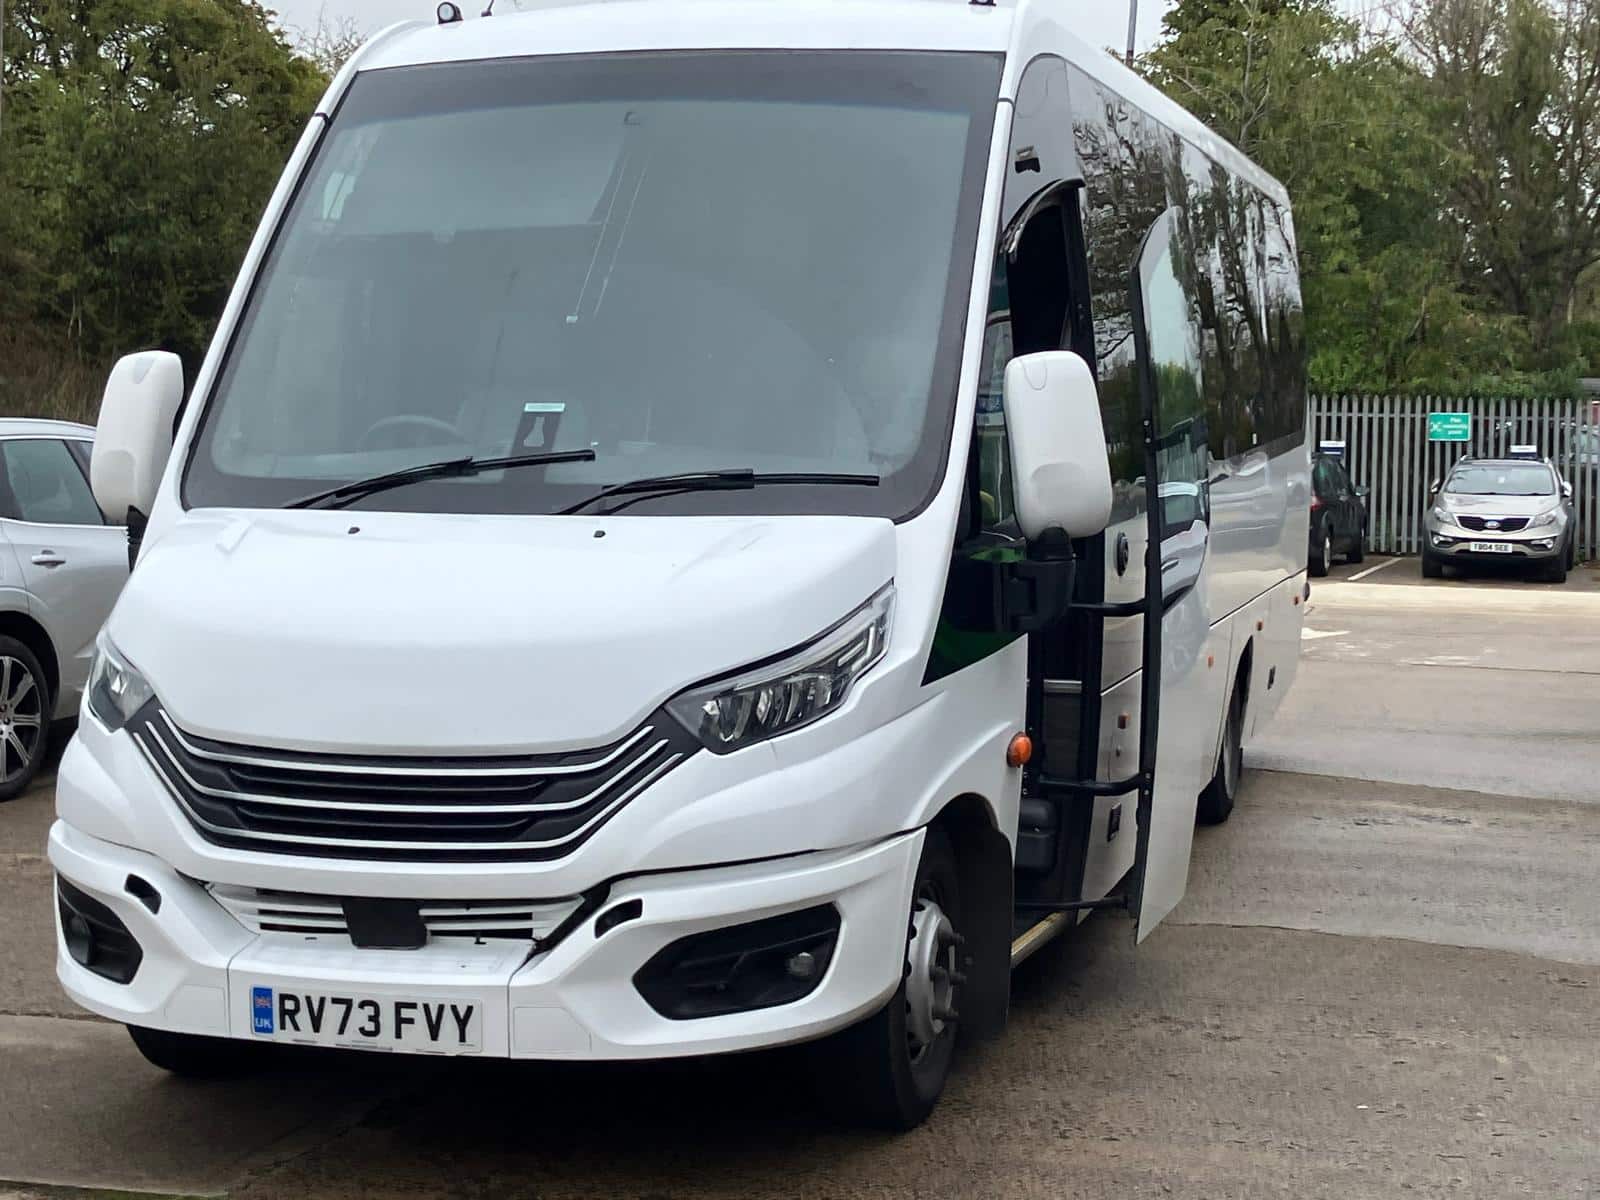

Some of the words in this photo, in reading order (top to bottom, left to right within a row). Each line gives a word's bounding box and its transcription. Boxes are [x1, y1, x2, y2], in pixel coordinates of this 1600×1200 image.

[255, 1017, 273, 1029] UK
[278, 993, 380, 1037] RV73
[394, 1001, 474, 1043] FVY
